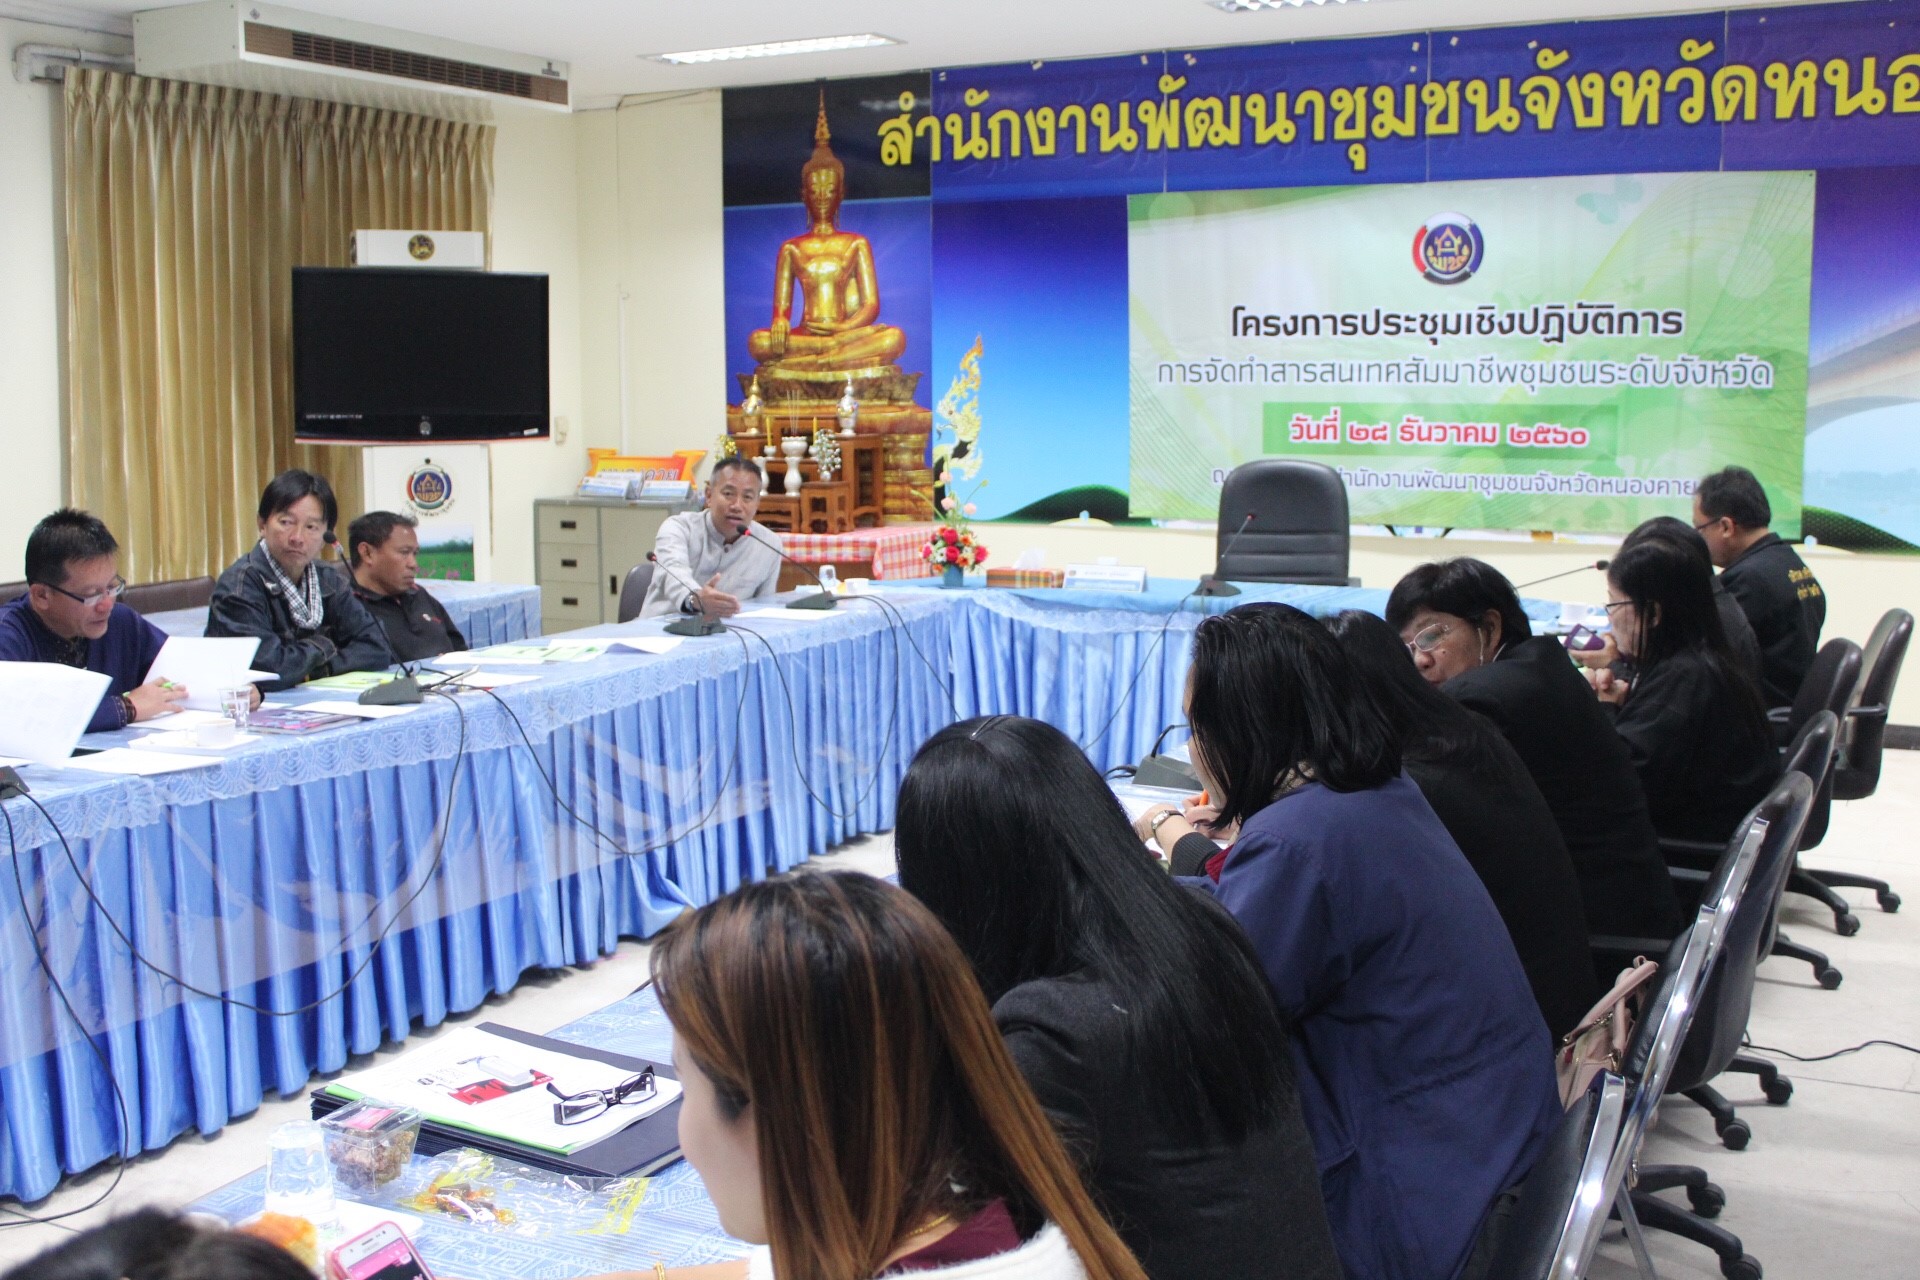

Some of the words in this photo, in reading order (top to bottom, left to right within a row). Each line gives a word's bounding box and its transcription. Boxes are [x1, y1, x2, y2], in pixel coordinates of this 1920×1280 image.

[1232, 302, 1683, 346] โครงการประชุมเชิงปฏิบัติการ
[1158, 356, 1771, 391] การจัดทำสารสนเทศสัมมาชีพชุมชนระดับจังหวัด
[1291, 409, 1339, 440] วันที่
[1348, 423, 1388, 442] ๒๘
[1399, 417, 1497, 443] ธันวาคม
[1508, 424, 1588, 445] ๒๕๖๐
[1339, 467, 1699, 496] ำนักงานพัฒนาชุมชนจังหวัดหนองคาย
